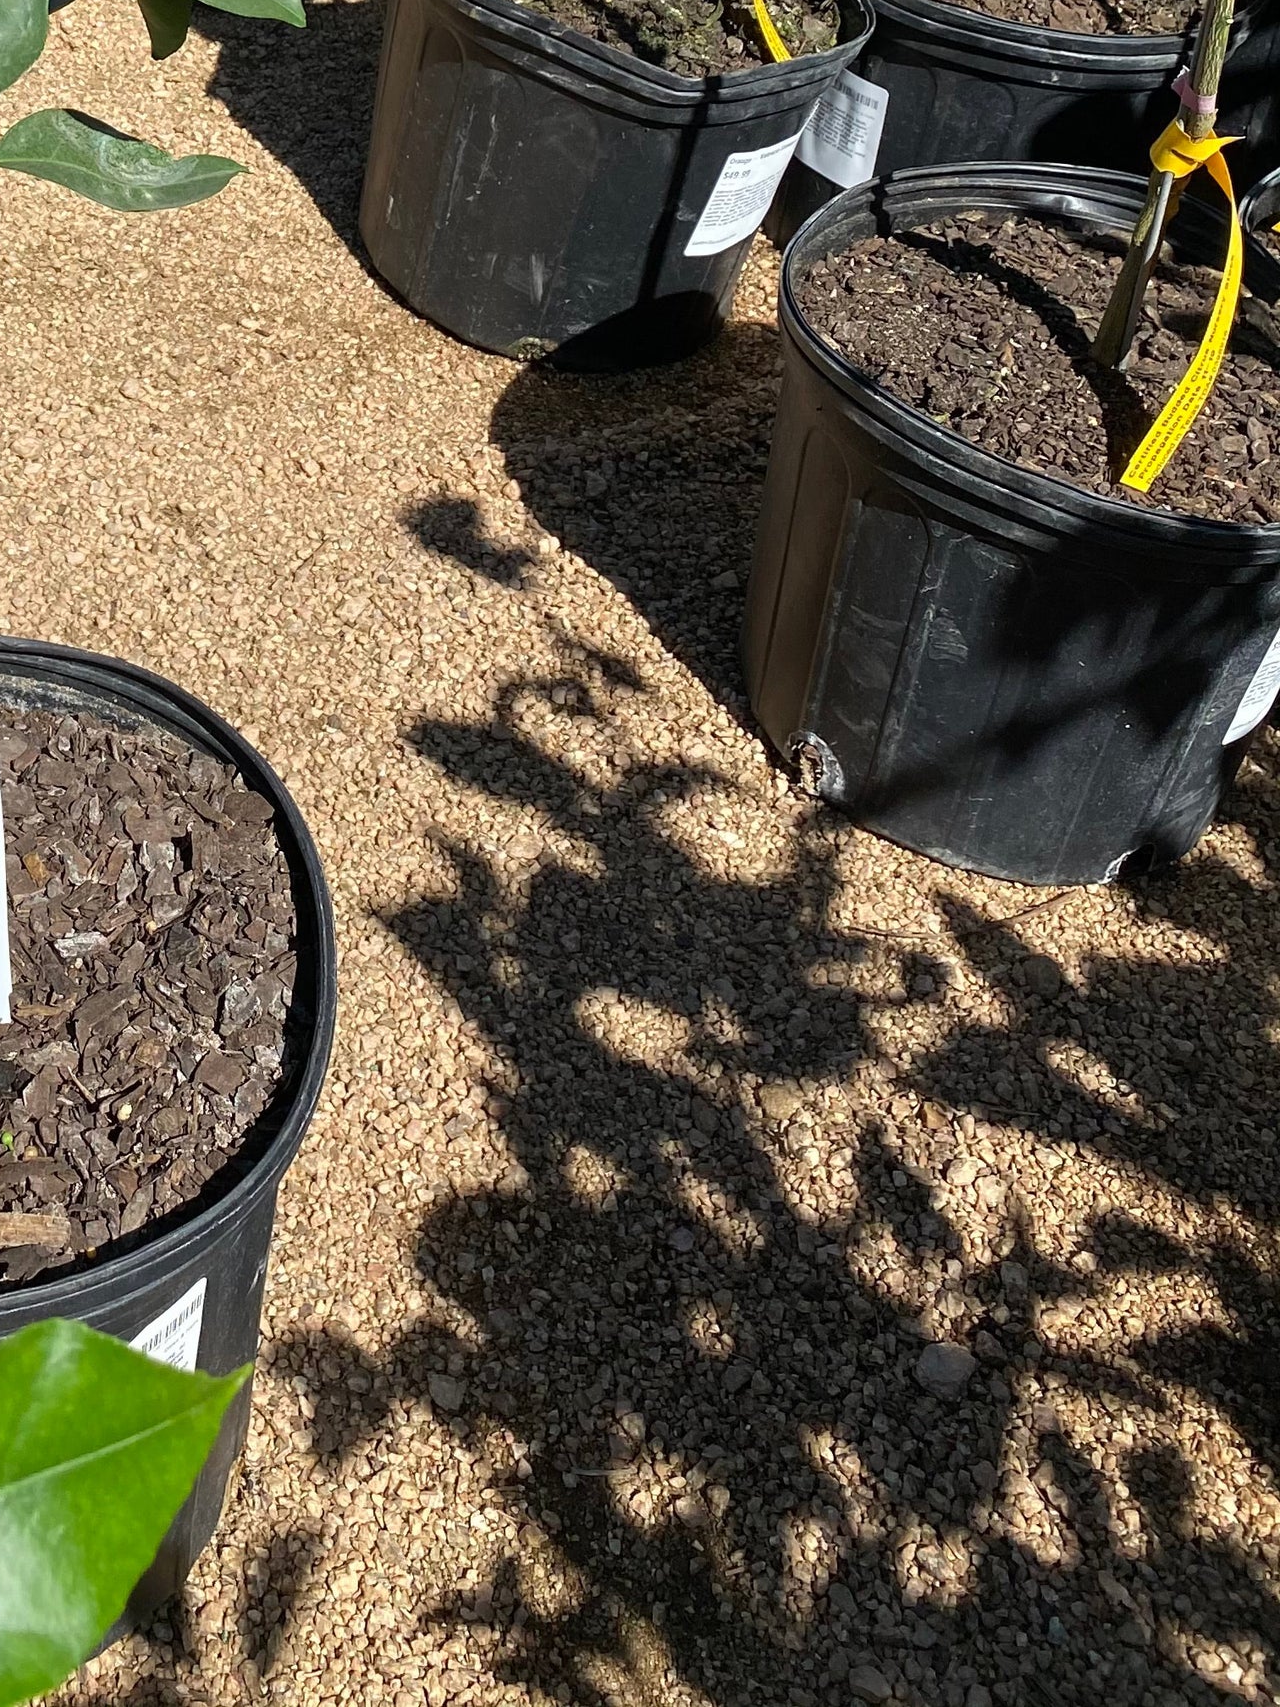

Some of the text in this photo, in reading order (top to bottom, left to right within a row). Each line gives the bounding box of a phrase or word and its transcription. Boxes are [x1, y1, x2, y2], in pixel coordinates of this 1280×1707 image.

[1128, 430, 1162, 478] Certified
[1162, 386, 1190, 427] Budded
[1190, 348, 1209, 382] Citrus
[1138, 415, 1183, 479] Propagation
[1182, 386, 1201, 411] Date
[1146, 443, 1176, 484] Produced
[1180, 404, 1200, 430] Texas
